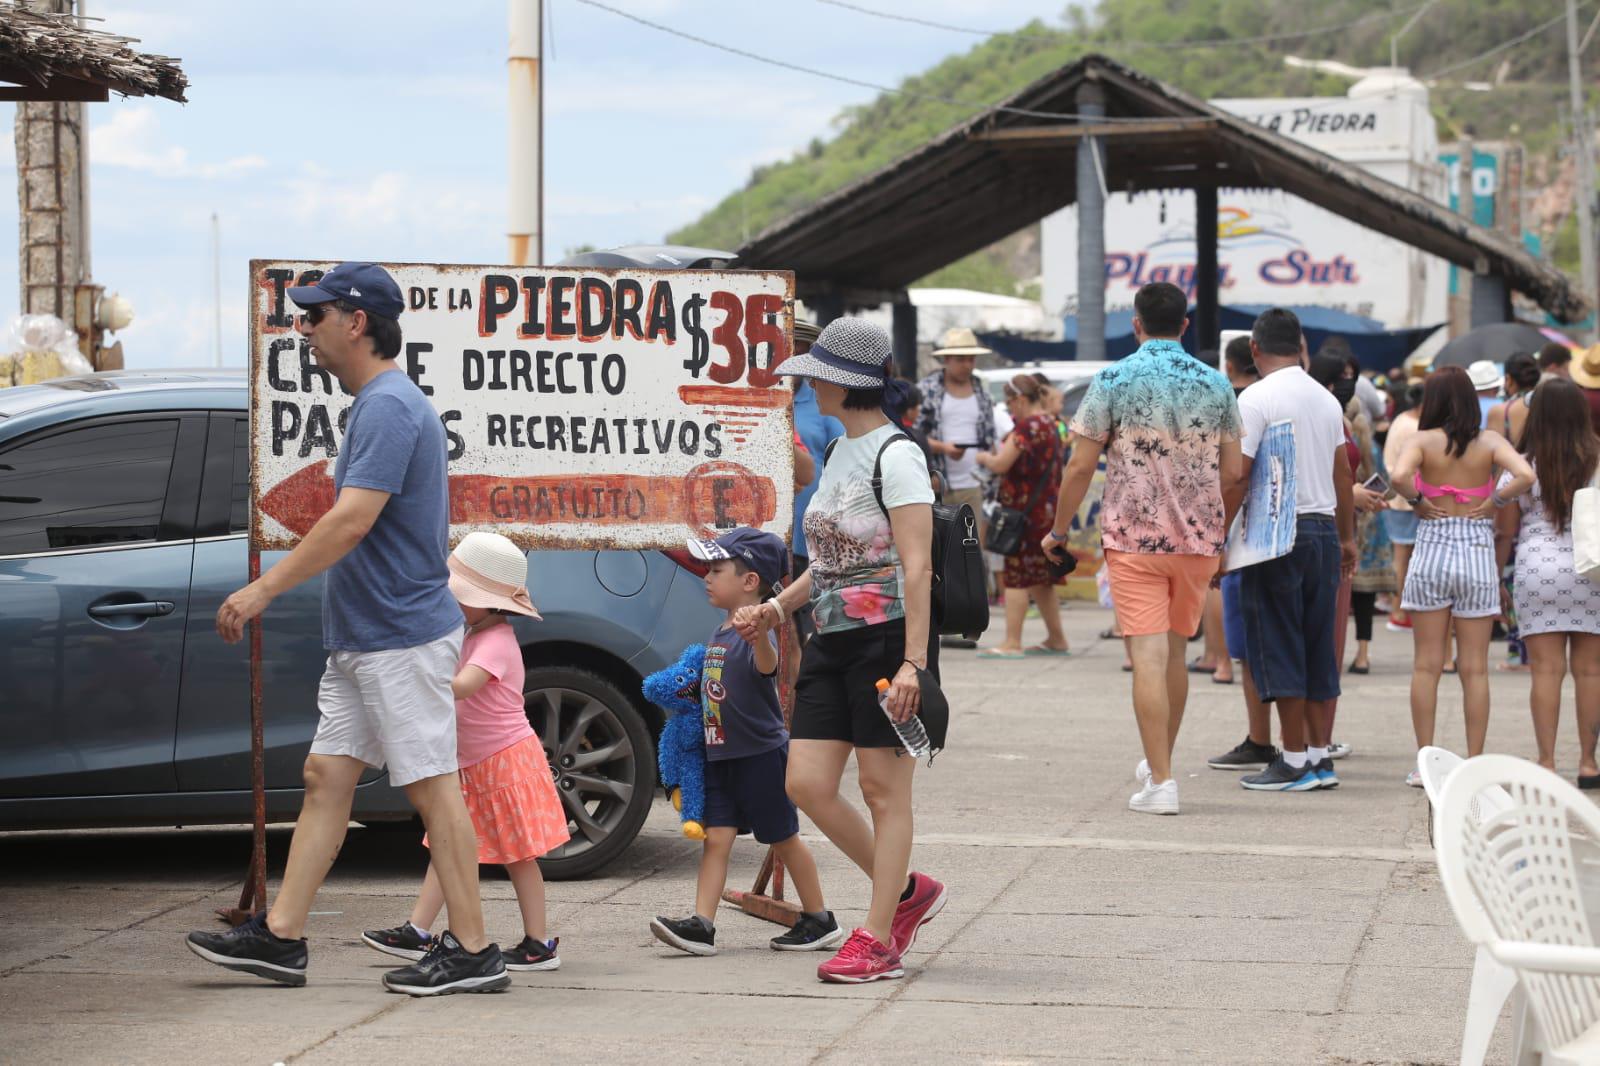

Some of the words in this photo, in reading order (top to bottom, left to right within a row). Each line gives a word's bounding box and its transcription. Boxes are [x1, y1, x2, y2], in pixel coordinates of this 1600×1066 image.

[1292, 108, 1377, 132] PIEDRA
[1259, 249, 1361, 286] Sur
[409, 287, 438, 310] DE
[448, 288, 473, 312] LA
[478, 275, 677, 345] PIEDRA
[267, 337, 434, 396] CRE
[463, 349, 627, 395] DIRECTO
[271, 400, 466, 461] PAS
[487, 413, 723, 458] RECREATIVOS
[490, 484, 646, 521] GRATUITO
[712, 478, 738, 529] E
